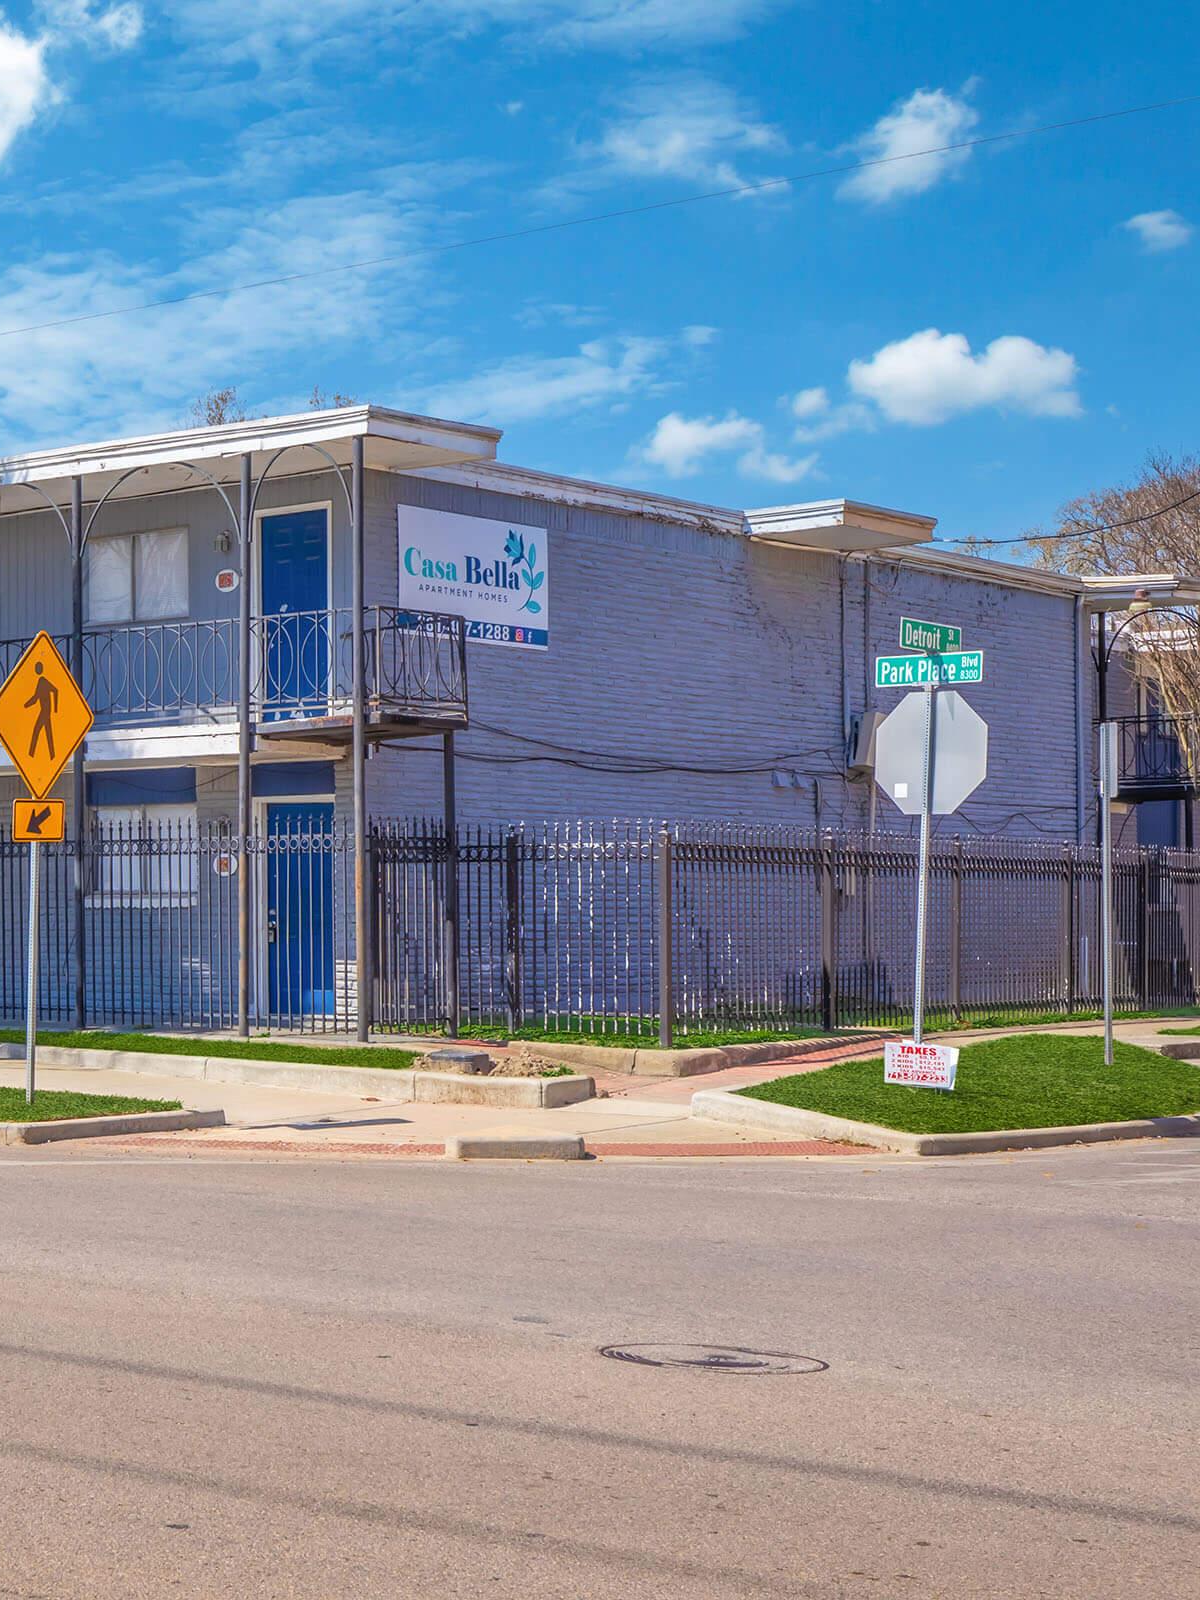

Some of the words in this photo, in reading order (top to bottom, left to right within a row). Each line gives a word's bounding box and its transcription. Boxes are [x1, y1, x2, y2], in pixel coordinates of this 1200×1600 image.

[404, 547, 457, 582] Casa
[464, 555, 520, 590] Bella
[418, 584, 473, 599] APARTMENT
[478, 591, 508, 603] HOMES
[417, 615, 510, 641] 81-7-1288
[905, 623, 941, 649] Detroit
[948, 629, 954, 641] St
[881, 661, 913, 683] Park
[917, 659, 956, 681] Place
[961, 655, 978, 668] Blvd
[960, 669, 978, 680] 8300
[900, 1045, 937, 1056] TAXES
